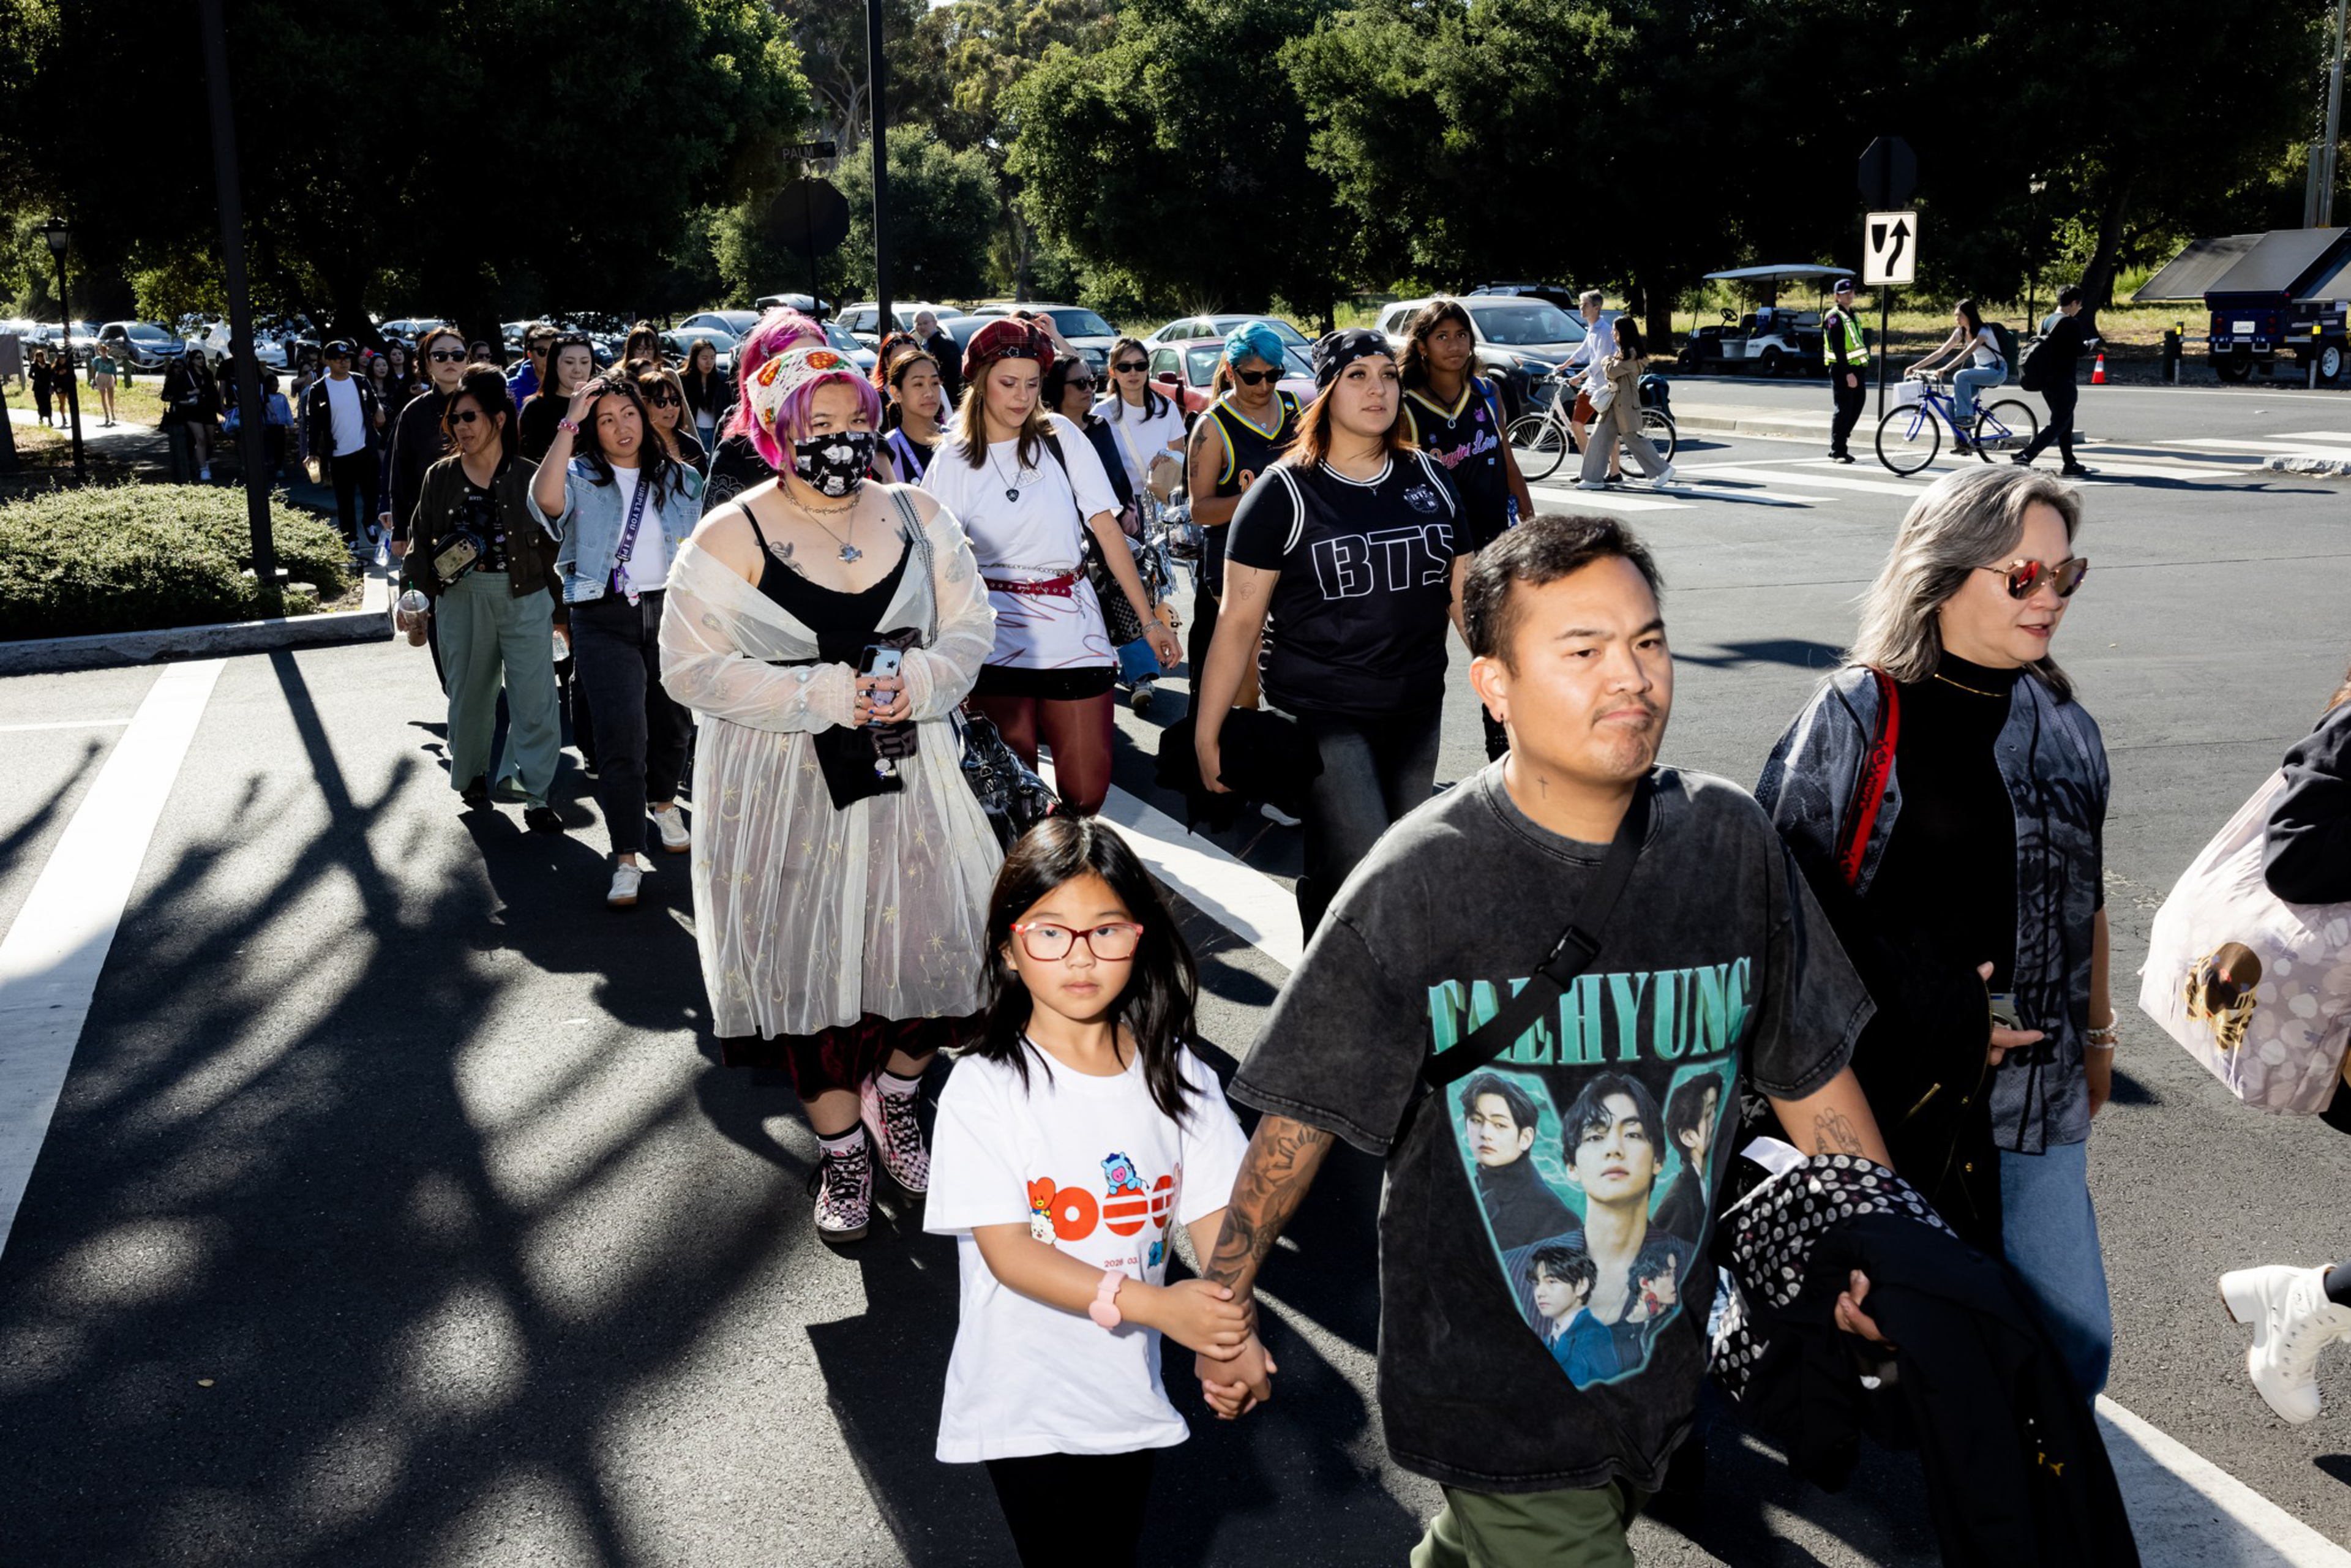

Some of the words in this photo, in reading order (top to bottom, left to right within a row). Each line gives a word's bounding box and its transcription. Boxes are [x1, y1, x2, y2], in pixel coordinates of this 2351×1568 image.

[782, 145, 814, 160] PALM
[634, 481, 647, 512] PURPLE
[629, 513, 639, 531] YOU
[1311, 523, 1453, 600] BTS
